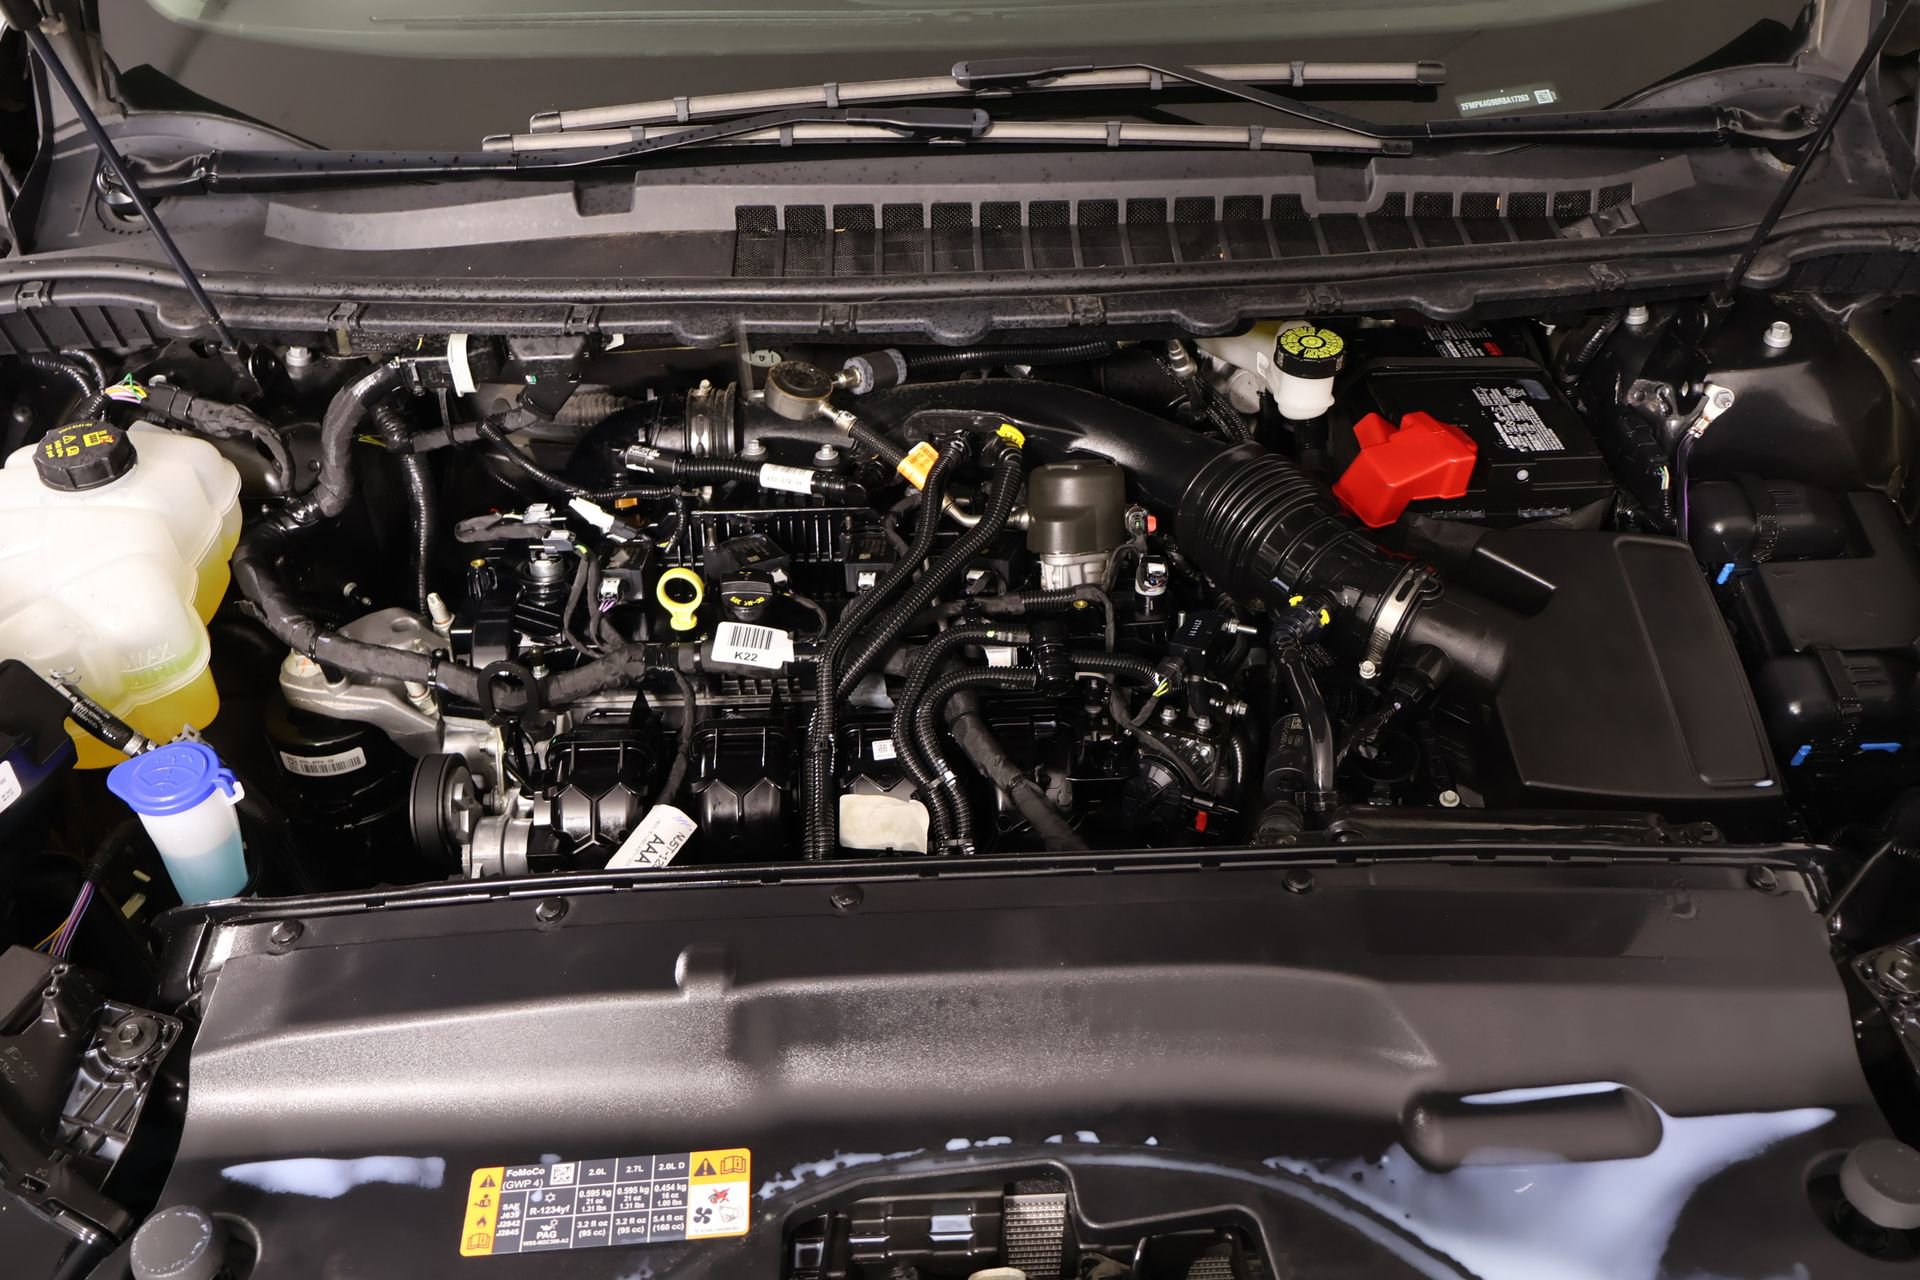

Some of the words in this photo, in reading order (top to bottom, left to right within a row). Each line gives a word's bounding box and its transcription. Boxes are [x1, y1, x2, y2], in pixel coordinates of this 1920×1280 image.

[735, 652, 758, 661] K22
[634, 833, 666, 864] AAA
[626, 1165, 644, 1173] 2.7L
[658, 1162, 677, 1171] 2.0L
[506, 1167, 545, 1177] FoMoCo
[588, 1168, 607, 1176] 2.0L
[502, 1180, 532, 1190] (GWP
[533, 1179, 544, 1188] 4)
[654, 1184, 676, 1192] 0.454
[676, 1183, 687, 1192] kg
[579, 1189, 600, 1198] 0.595
[601, 1189, 612, 1198] kg
[616, 1186, 638, 1195] 0.595
[639, 1185, 650, 1194] kg
[529, 1204, 570, 1216] R-1234yf
[500, 1211, 520, 1219] J639
[652, 1215, 665, 1223] 5.4
[577, 1220, 589, 1228] 3.2
[615, 1217, 628, 1226] 3.2
[617, 1226, 631, 1235] (95
[631, 1225, 645, 1234] cc)
[671, 1223, 685, 1231] cc)
[536, 1230, 558, 1240] PAG
[578, 1229, 592, 1238] (95
[593, 1229, 606, 1237] cc)
